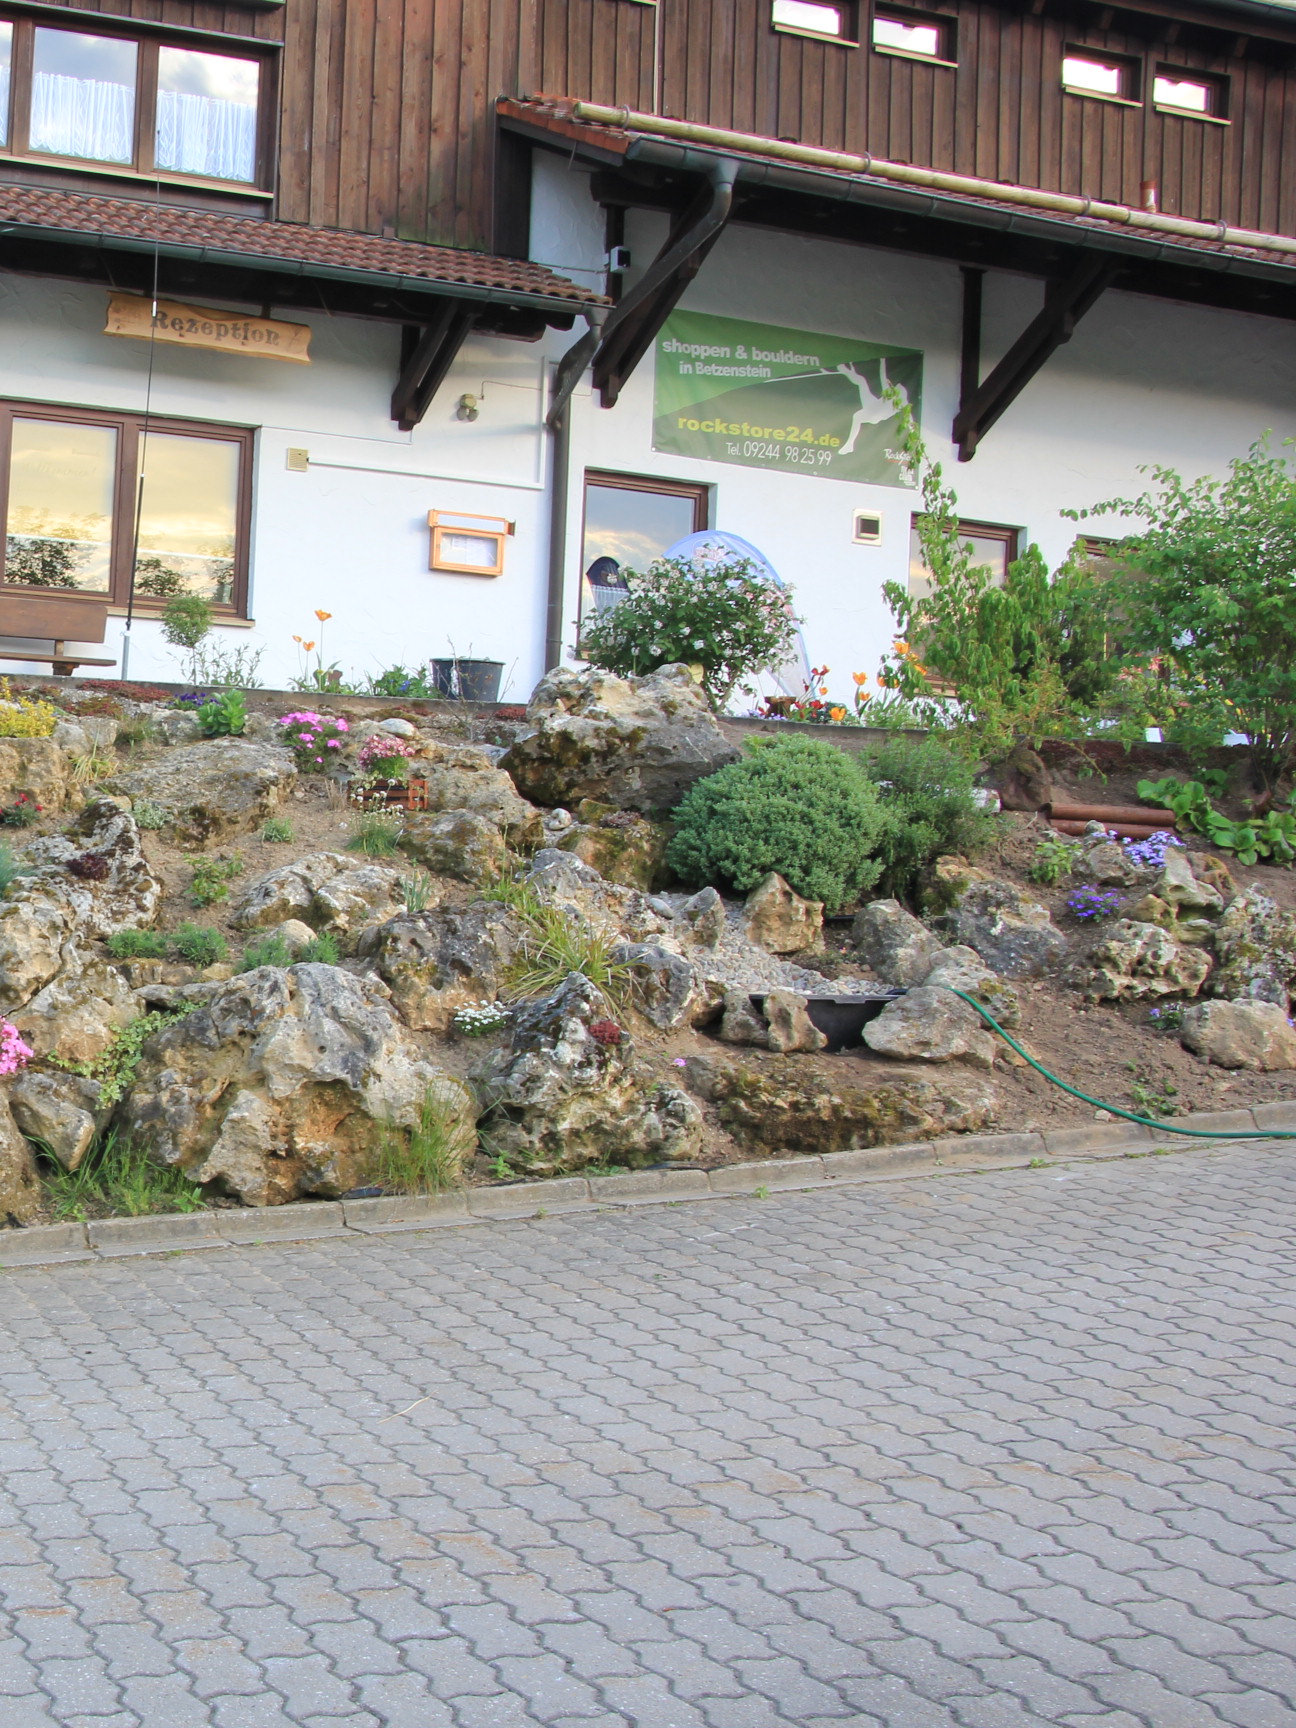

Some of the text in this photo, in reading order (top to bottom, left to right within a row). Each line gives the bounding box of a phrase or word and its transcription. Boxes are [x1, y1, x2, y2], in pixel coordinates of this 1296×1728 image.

[150, 310, 280, 346] Rezeption
[662, 338, 821, 366] shoppen & bouldern
[679, 361, 772, 378] in Betzenstein
[677, 417, 841, 447] rockstore24.de
[725, 440, 832, 467] Tel. 09244 98 25 99
